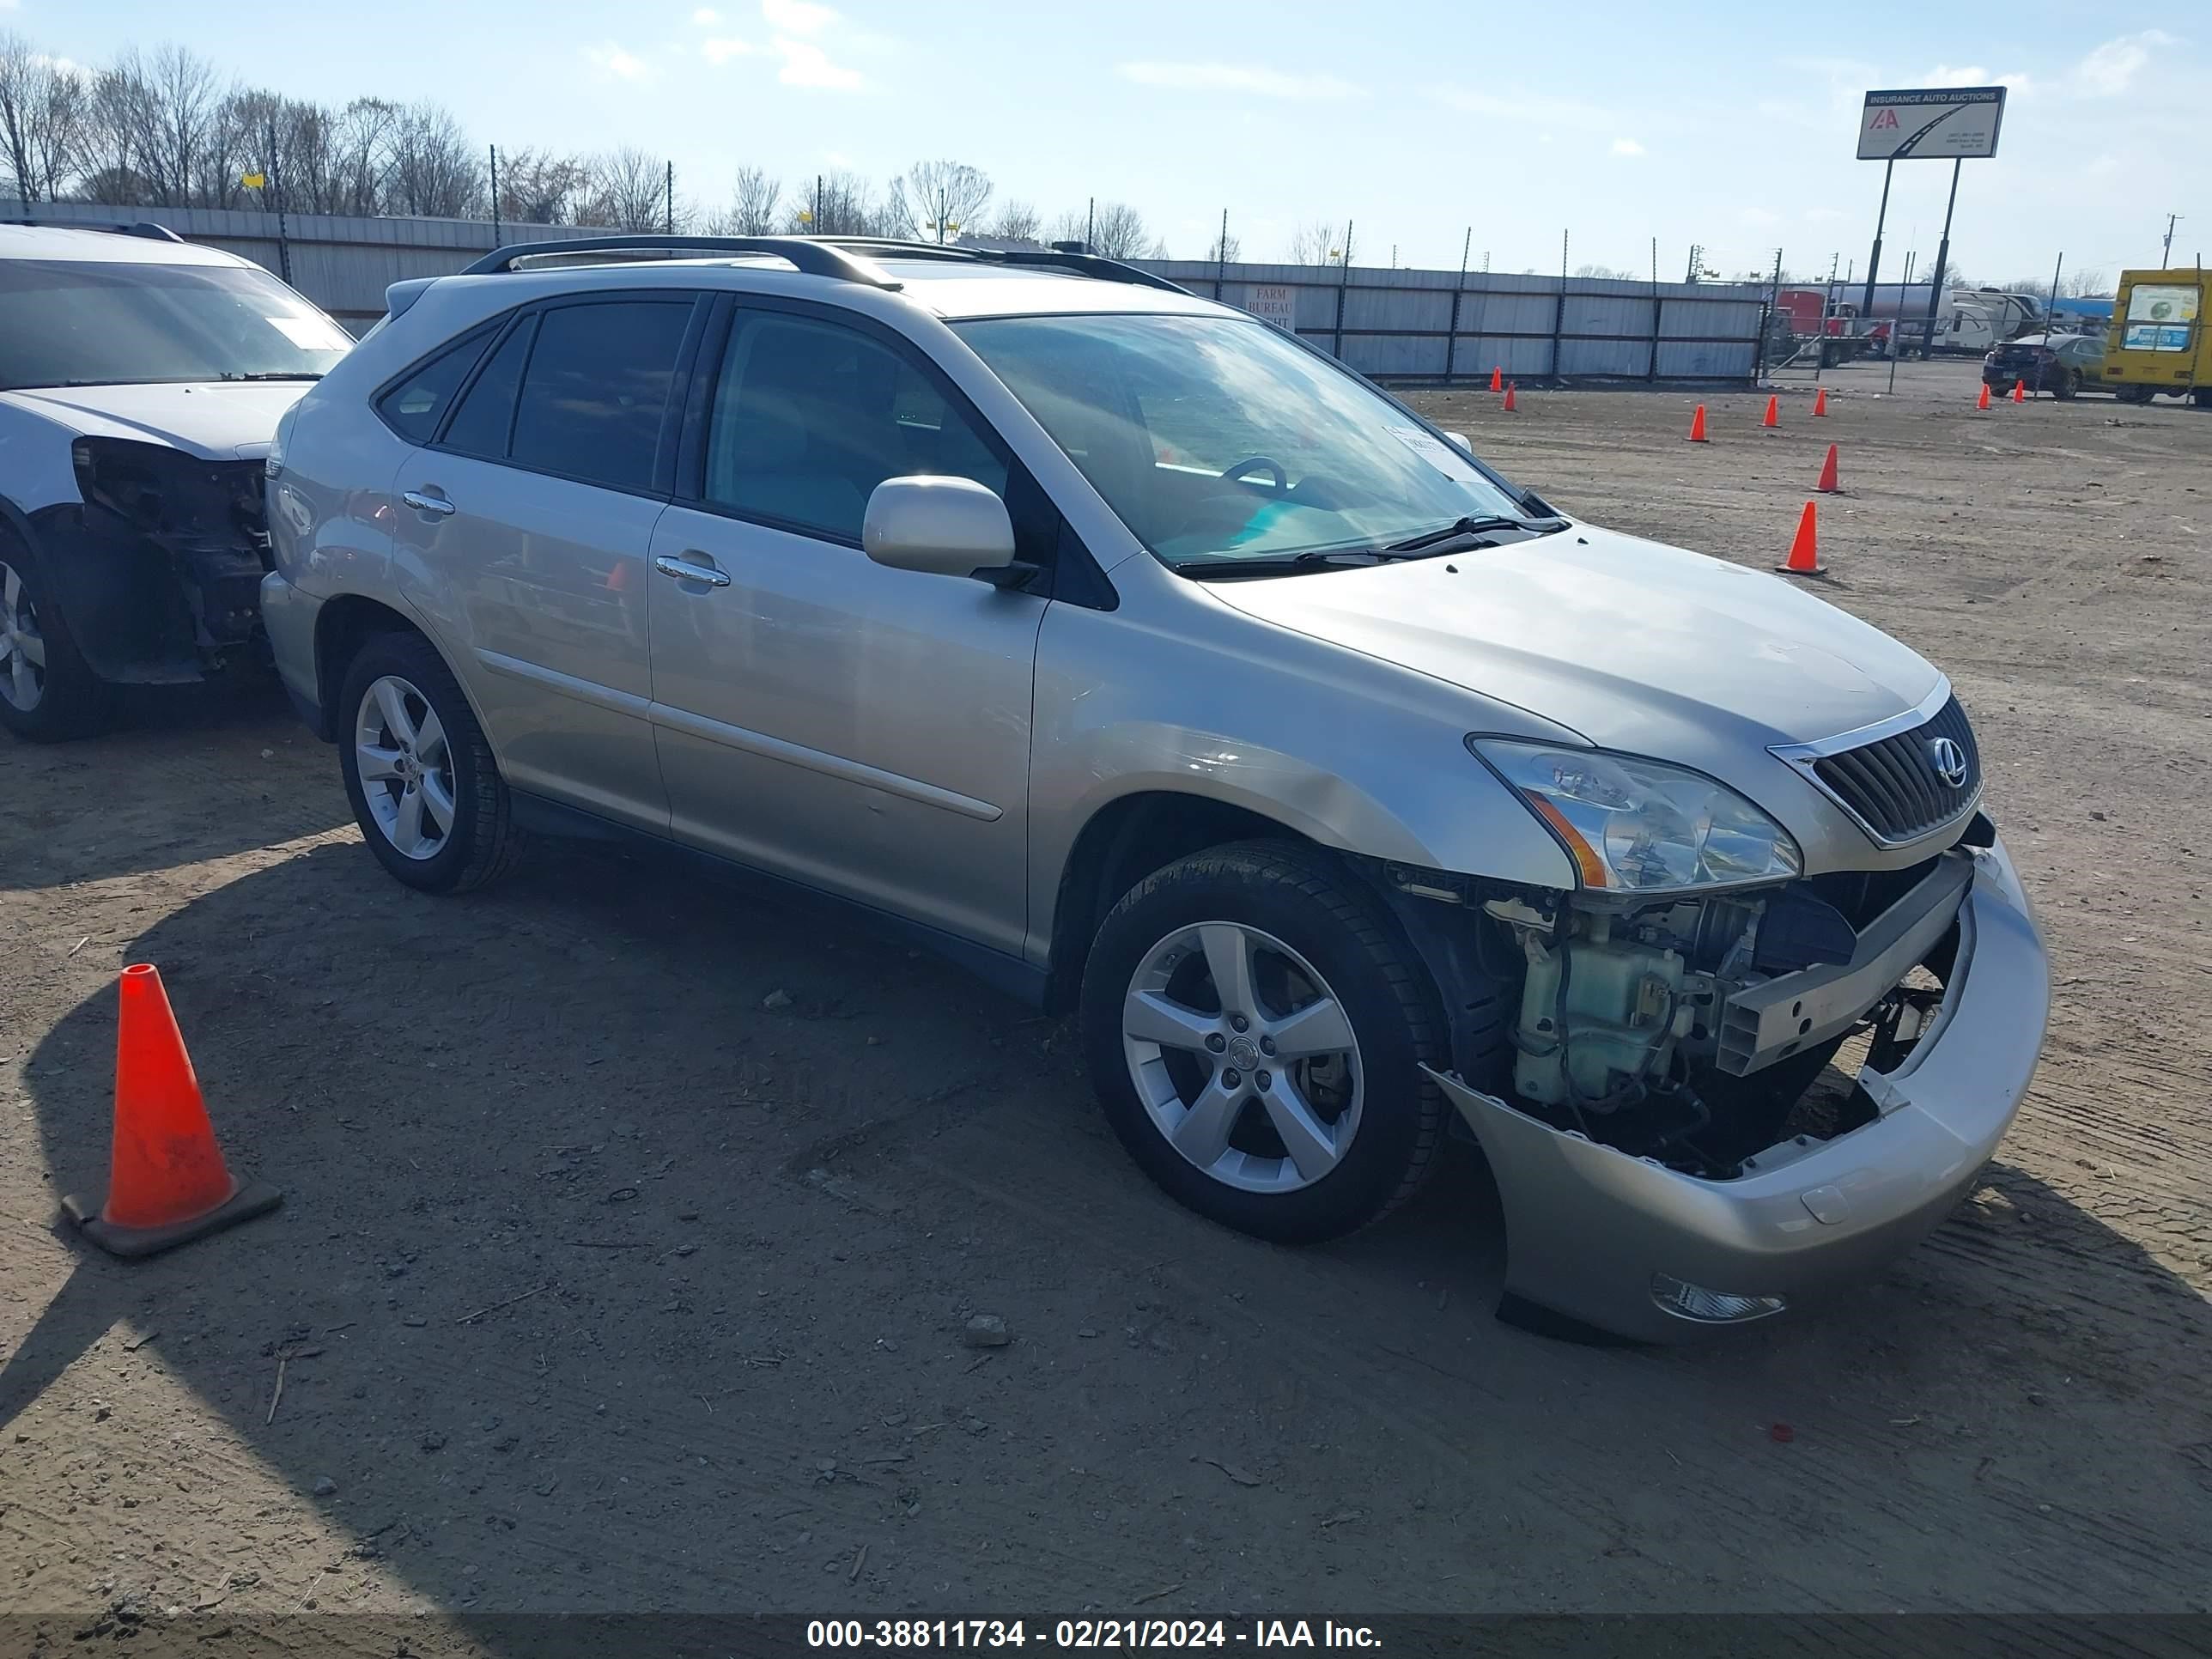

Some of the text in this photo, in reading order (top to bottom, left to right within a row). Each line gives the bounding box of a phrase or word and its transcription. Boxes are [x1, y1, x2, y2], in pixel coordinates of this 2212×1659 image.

[1870, 92, 1996, 104] INSURANCE AUTO AUCTIONS
[1256, 288, 1286, 300] FARM
[1249, 301, 1292, 313] BUREAU
